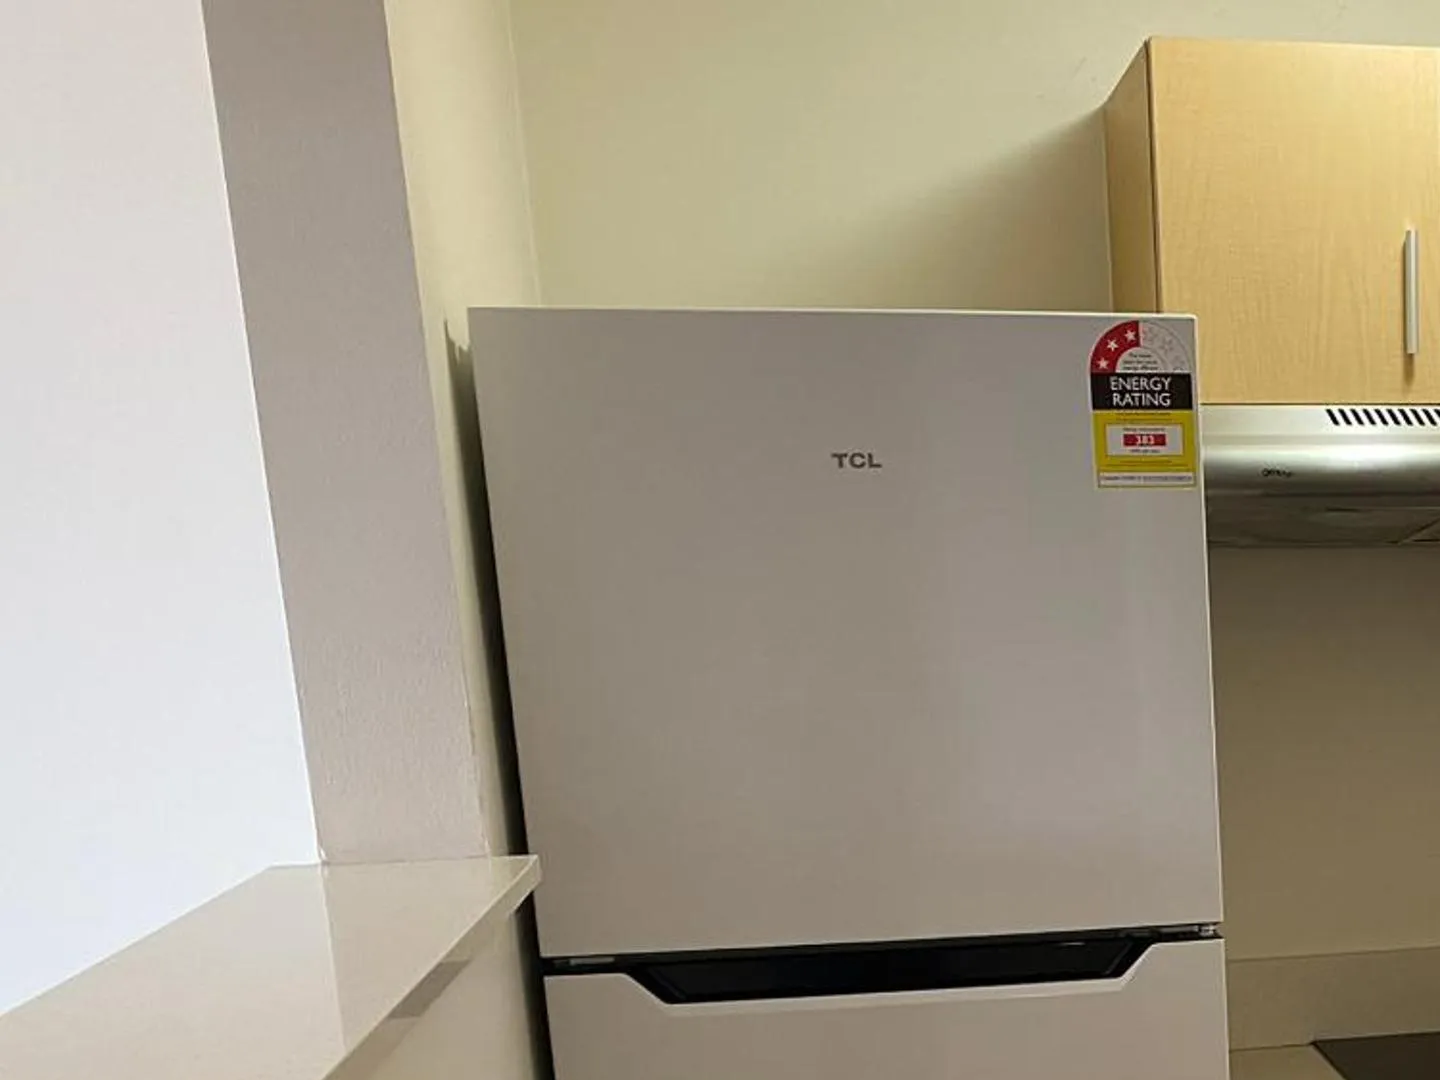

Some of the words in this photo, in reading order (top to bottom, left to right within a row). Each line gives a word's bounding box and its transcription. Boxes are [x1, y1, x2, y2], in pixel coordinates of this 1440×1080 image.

[1110, 376, 1171, 391] ENERGY
[1112, 392, 1171, 407] RATING
[831, 452, 882, 469] TCL
